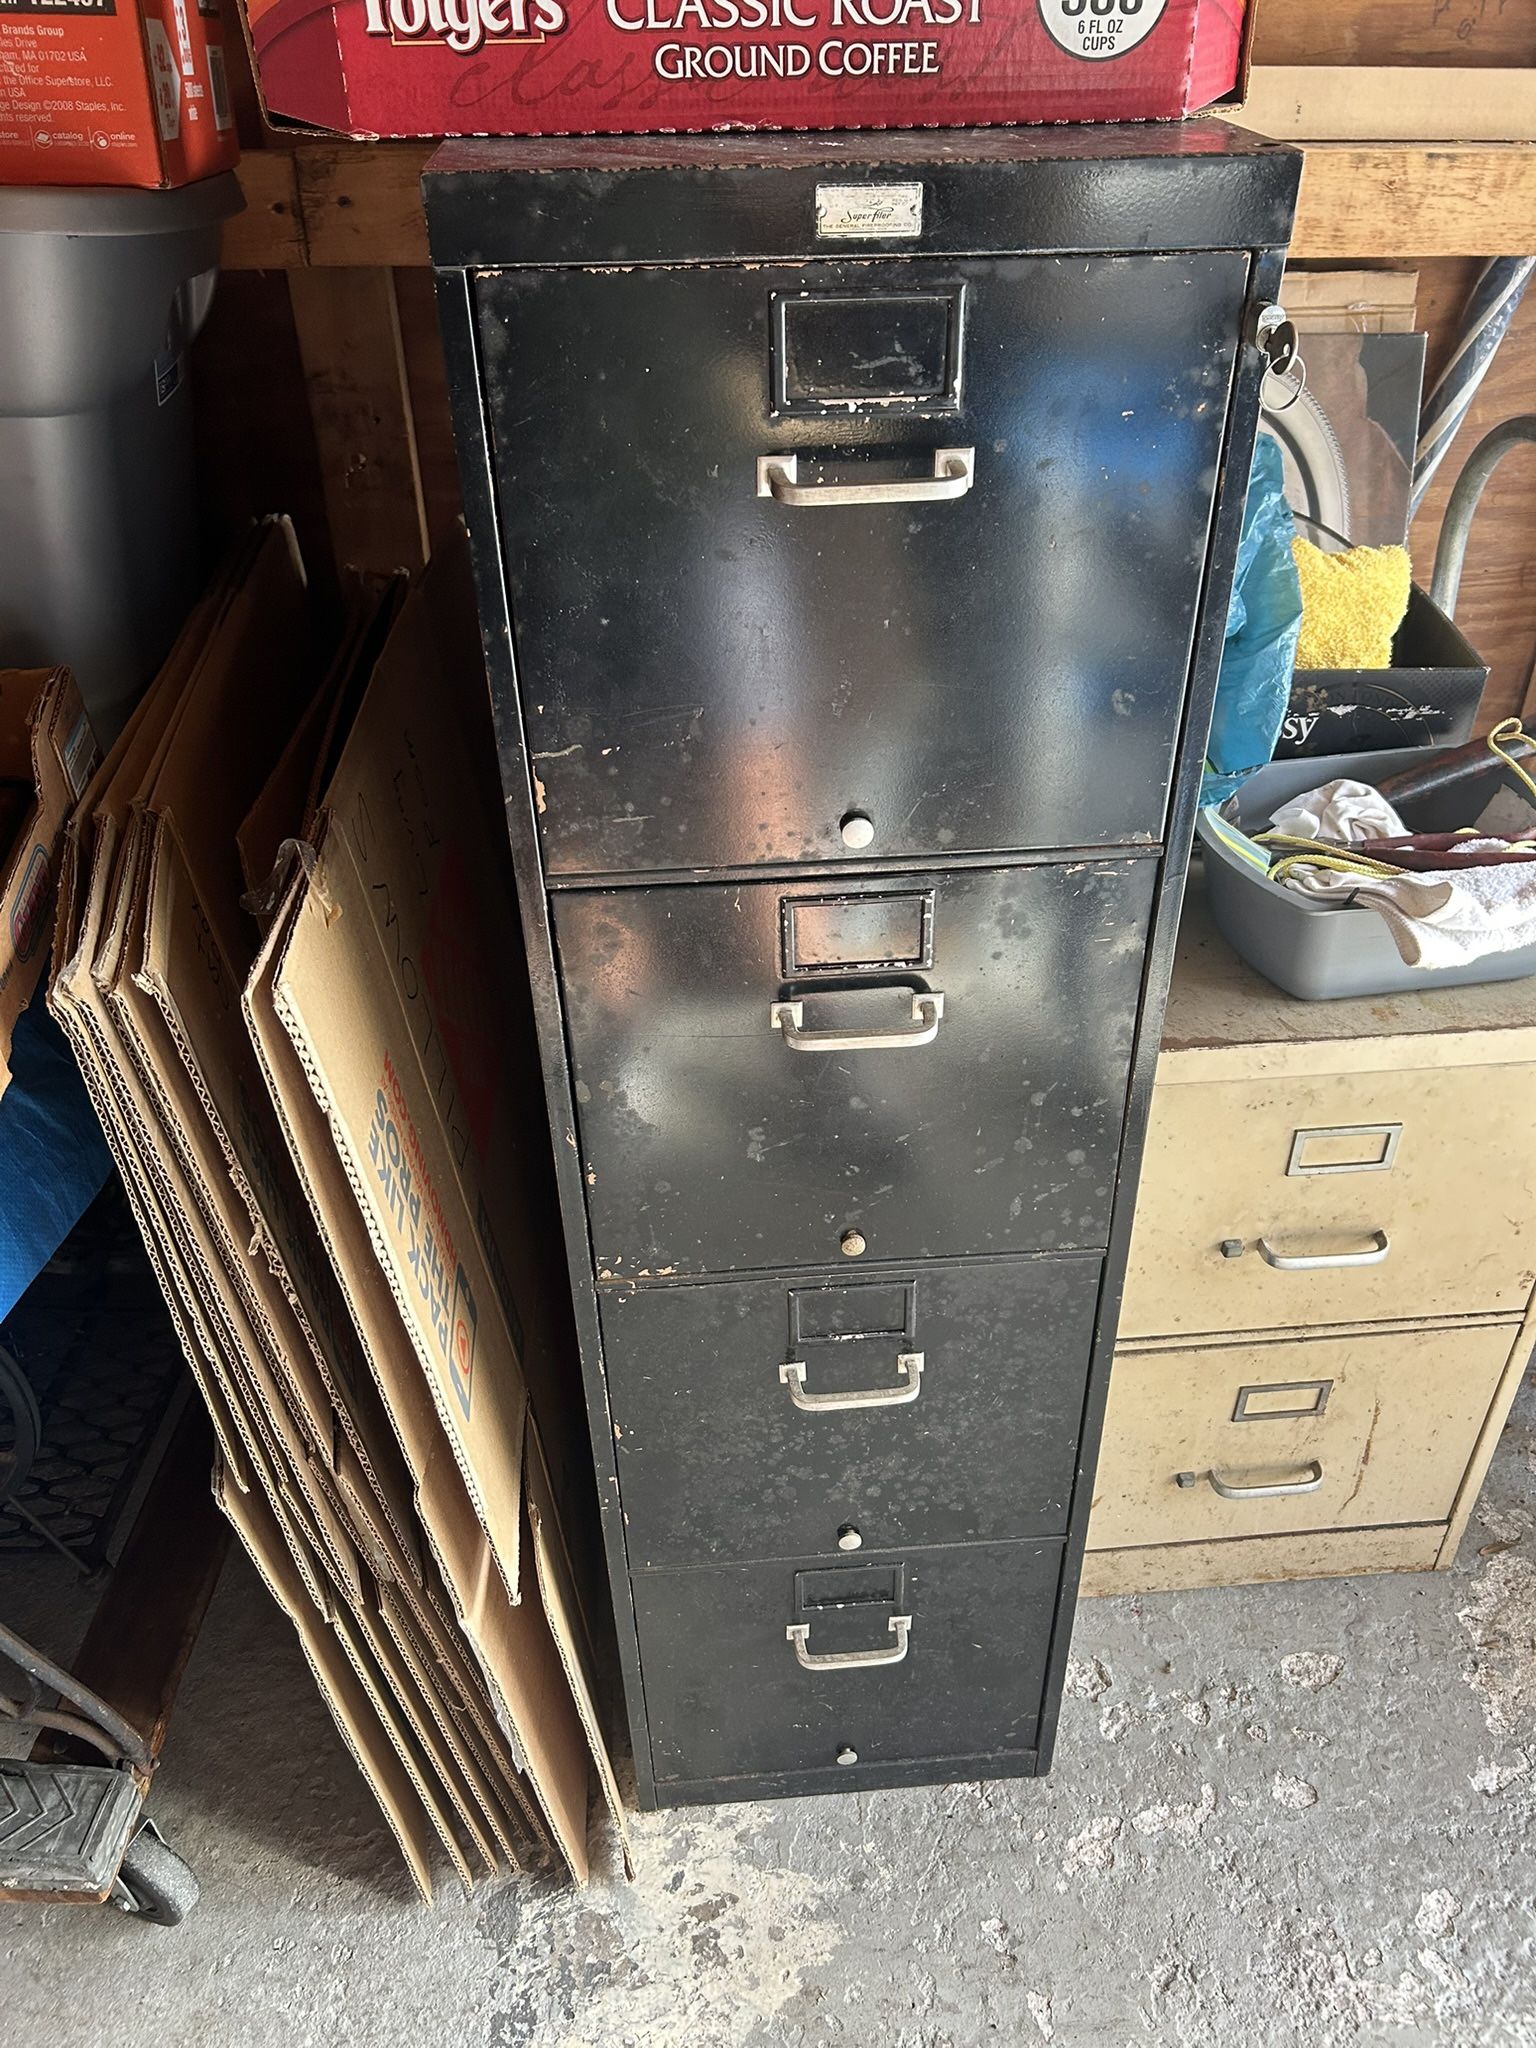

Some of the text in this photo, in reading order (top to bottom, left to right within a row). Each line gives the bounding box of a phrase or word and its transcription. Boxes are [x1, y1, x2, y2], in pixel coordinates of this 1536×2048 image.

[2, 23, 64, 38] Brands Group
[606, 0, 982, 30] CLASSIC ROAST
[1077, 19, 1124, 34] 6 FL OZ
[22, 50, 37, 60] MA
[38, 51, 66, 61] 01702
[67, 51, 87, 61] USA
[655, 40, 940, 79] GROUND COFFEE
[1082, 35, 1116, 51] CUPS
[19, 76, 43, 86] Office
[53, 131, 84, 141] catalog
[110, 132, 136, 140] online
[1281, 711, 1320, 745] sy
[352, 791, 472, 1171] PILLOWS
[375, 1088, 421, 1230] PROS
[383, 1049, 457, 1273] HDMOVING.COM
[368, 1117, 404, 1236] LIKE
[423, 1221, 450, 1319] THE
[407, 1221, 448, 1357] PACK
